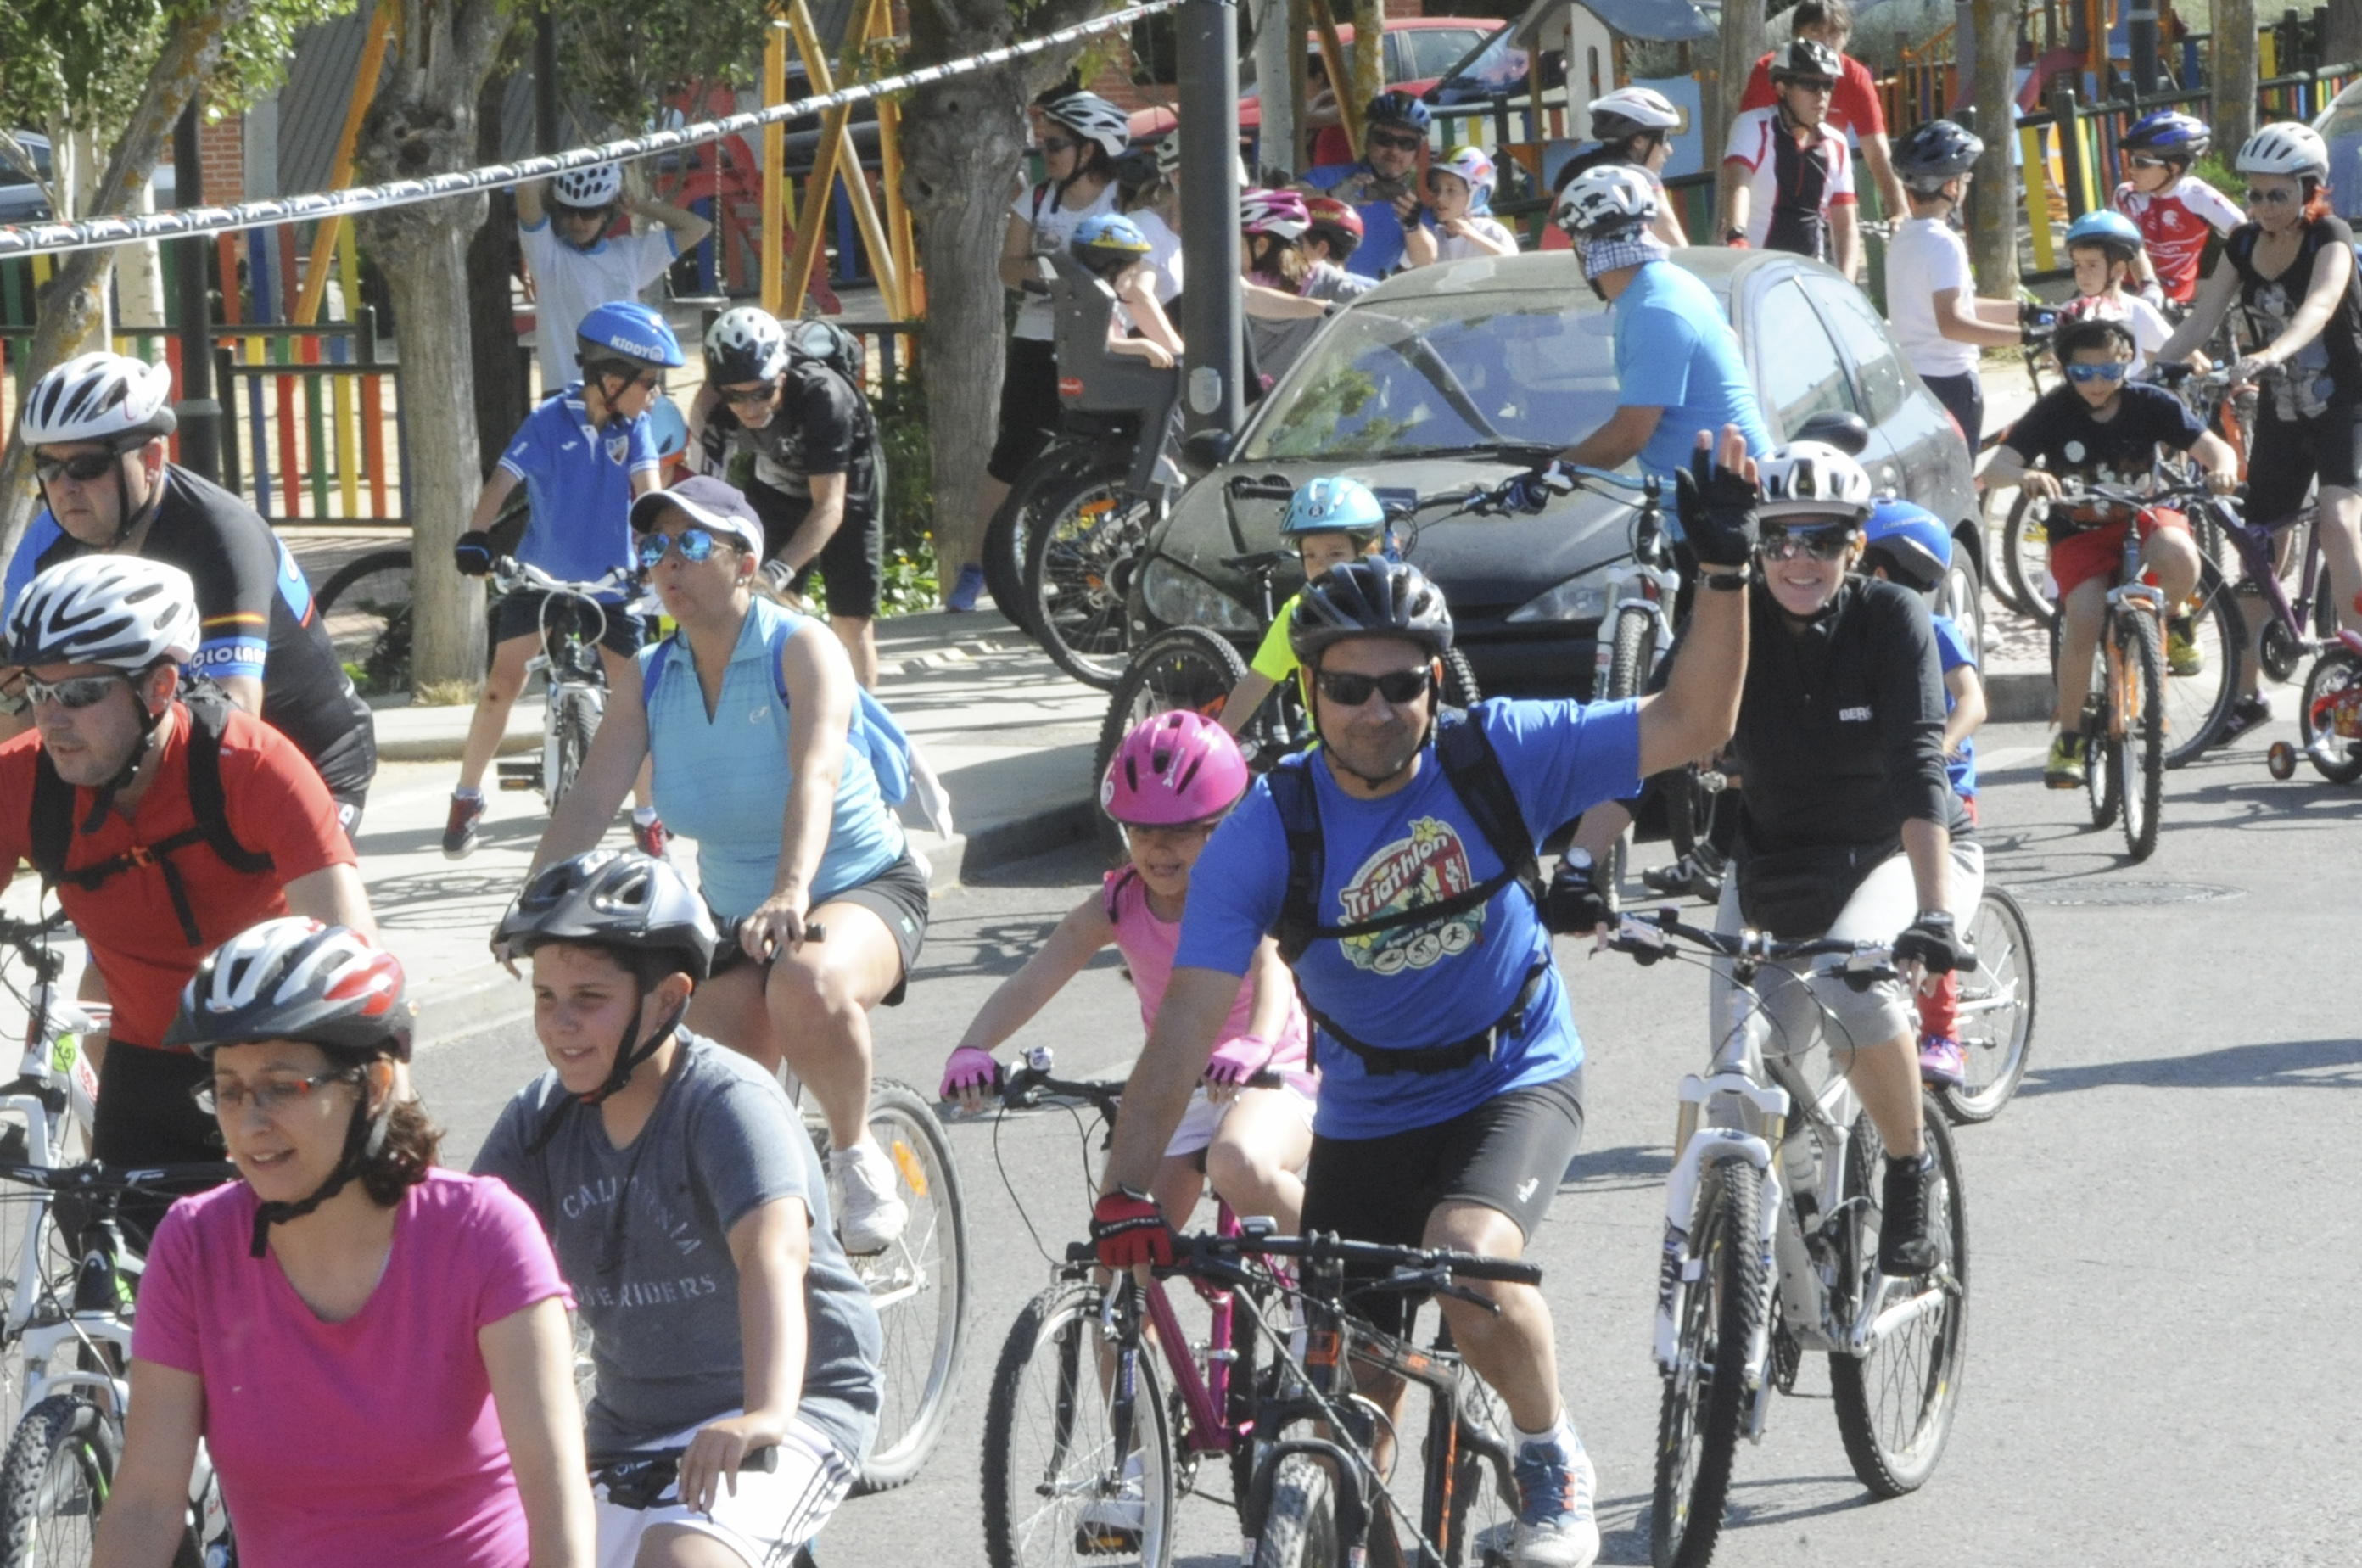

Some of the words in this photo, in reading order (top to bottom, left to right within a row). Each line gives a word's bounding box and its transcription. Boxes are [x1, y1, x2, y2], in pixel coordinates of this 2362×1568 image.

[611, 335, 649, 357] KIDDY
[1342, 834, 1449, 918] Triathlon
[620, 1274, 717, 1308] RIDERS
